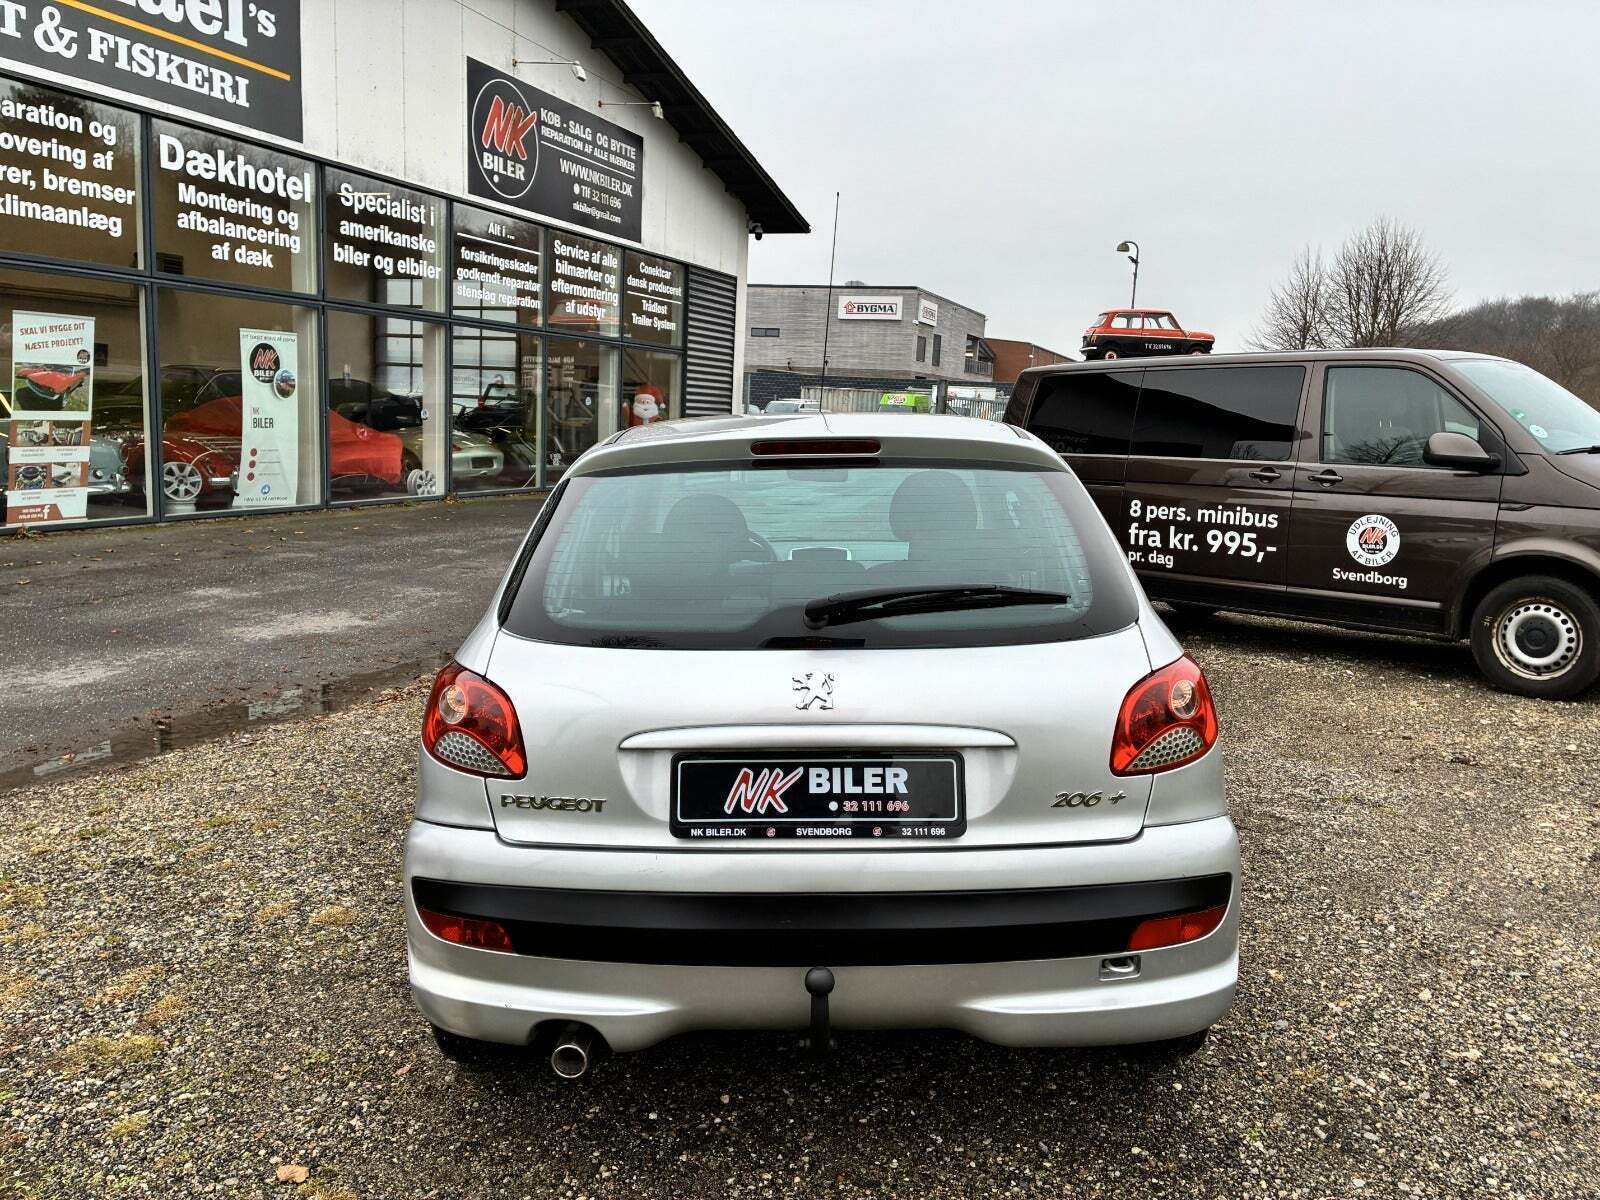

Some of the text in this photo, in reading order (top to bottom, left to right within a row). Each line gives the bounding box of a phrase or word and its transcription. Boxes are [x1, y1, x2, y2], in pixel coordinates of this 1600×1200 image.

[113, 0, 277, 47] ael's
[34, 6, 78, 59] &
[87, 27, 249, 108] FISKERI
[89, 121, 117, 146] og
[481, 95, 537, 160] NK
[540, 107, 561, 127] KØB
[569, 120, 592, 141] SALG
[596, 132, 608, 148] OG
[610, 138, 636, 160] BYTTE
[92, 151, 114, 171] af
[541, 125, 635, 172] REPARATION AF ALLE MÆRKER
[159, 133, 311, 204] Dækhotel
[482, 151, 525, 181] BILER
[560, 157, 633, 197] WWW.NKBILER.DK
[43, 168, 136, 205] bremser
[591, 189, 600, 202] 32
[600, 192, 609, 205] 111
[610, 195, 622, 209] 696
[178, 182, 299, 232] Montering og
[340, 182, 435, 227] Specialist i
[572, 201, 622, 224] nkbiler@gmail.com
[177, 211, 301, 253] afbalancering
[340, 220, 436, 253] amerikanske
[488, 222, 501, 237] Alt
[211, 242, 273, 268] af dæk
[333, 242, 441, 280] biler og elbiler
[461, 246, 538, 275] forsikringsskader
[554, 239, 618, 268] Service af alle
[457, 266, 542, 292] godkendt reparatør
[555, 260, 616, 288] bilmærker og
[627, 275, 682, 297] dansk produceret
[456, 285, 542, 310] stenslag reparation
[551, 279, 619, 307] eftermontering
[565, 301, 606, 320] af udstyr
[641, 299, 668, 315] Trådløst
[856, 304, 895, 313] BYGMA
[20, 322, 85, 336] SKAL VI BYGGE DIT
[632, 313, 676, 331] Trailer System
[24, 337, 84, 351] NÆSTE PROJEKT?
[253, 347, 278, 369] NK
[252, 417, 274, 429] BILER
[1129, 499, 1278, 529] 8 pers. minibus
[1349, 516, 1398, 538] UDLEJNING
[1360, 527, 1388, 544] NK
[1128, 523, 1277, 563] fra kr. 995,-
[1128, 549, 1174, 568] pr. dag
[1352, 550, 1394, 565] AF BILER
[1332, 567, 1408, 589] Svendborg
[500, 793, 607, 813] PEUGEOT
[723, 766, 908, 815] NK BILER
[1050, 791, 1103, 808] 206
[843, 801, 909, 812] 32 111 696
[690, 828, 746, 837] NK BILER.DK
[796, 827, 852, 836] SVENDBORG
[902, 827, 945, 836] 32 111 696
